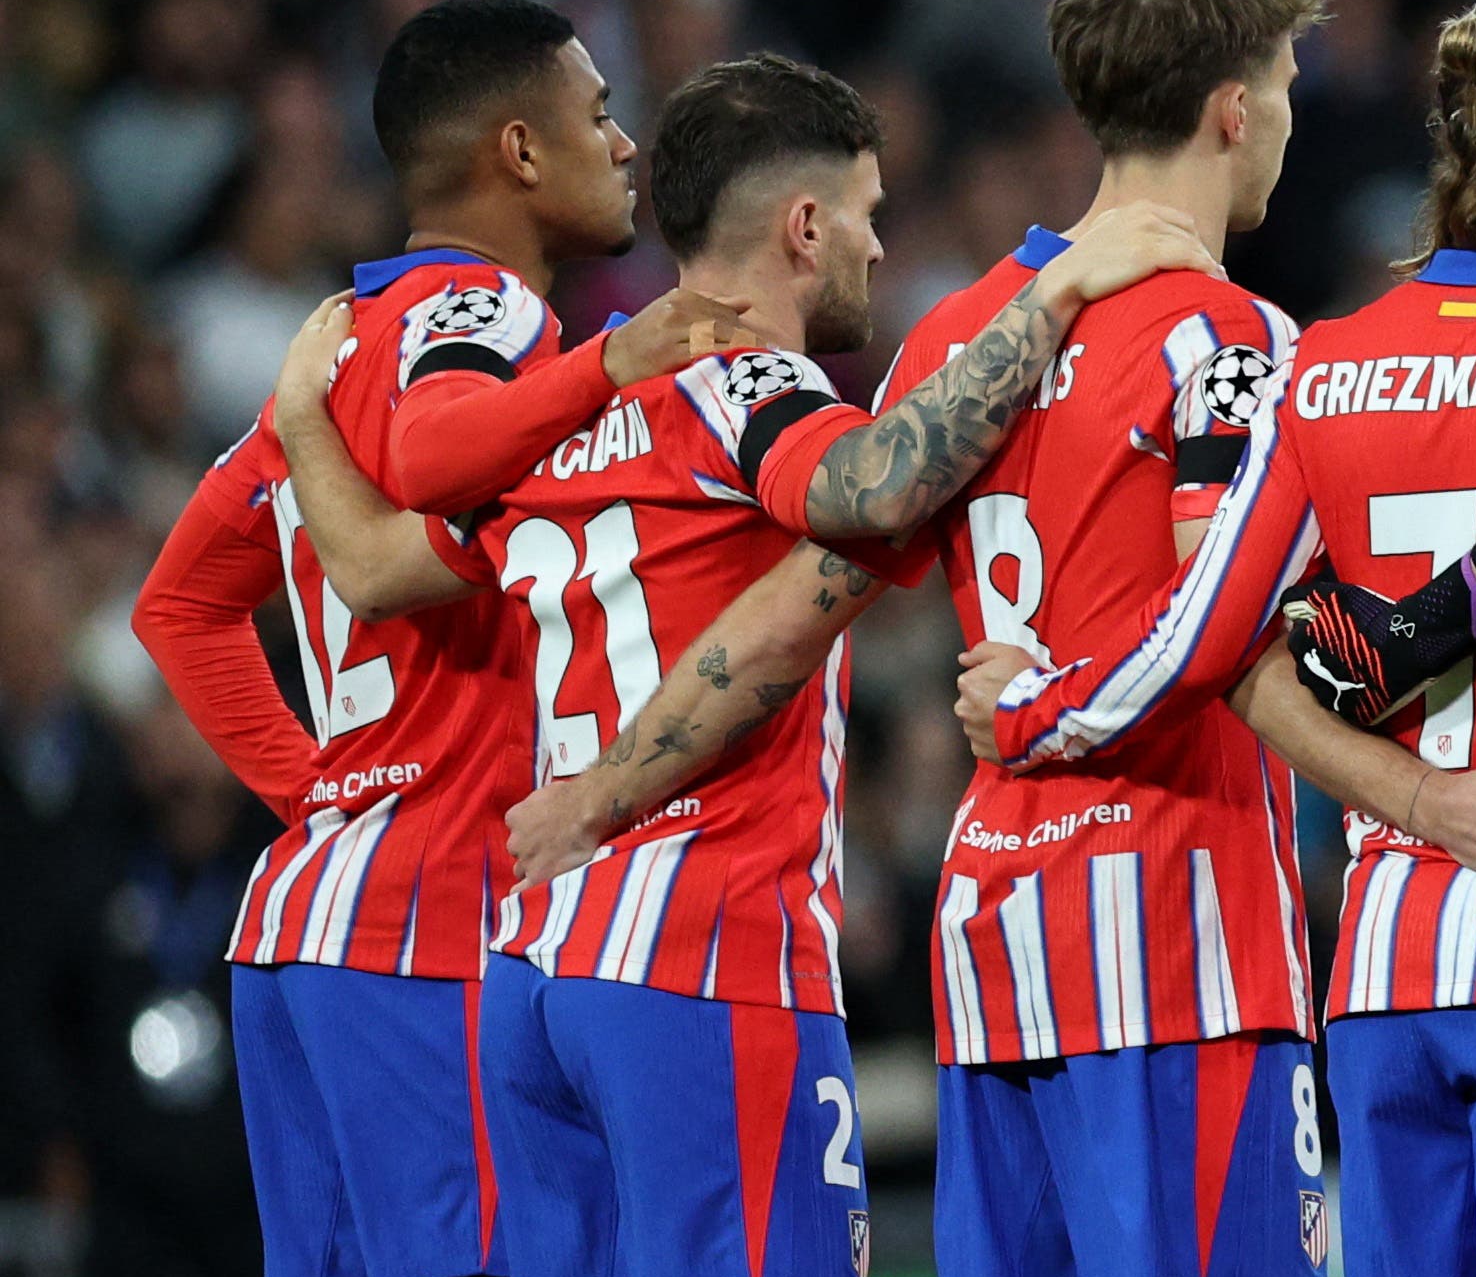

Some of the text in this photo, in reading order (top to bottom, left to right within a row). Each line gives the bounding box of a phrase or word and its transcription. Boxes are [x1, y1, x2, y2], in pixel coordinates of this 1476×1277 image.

[500, 499, 664, 779] 21
[816, 1076, 861, 1190] 2
[1291, 1064, 1323, 1177] 8
